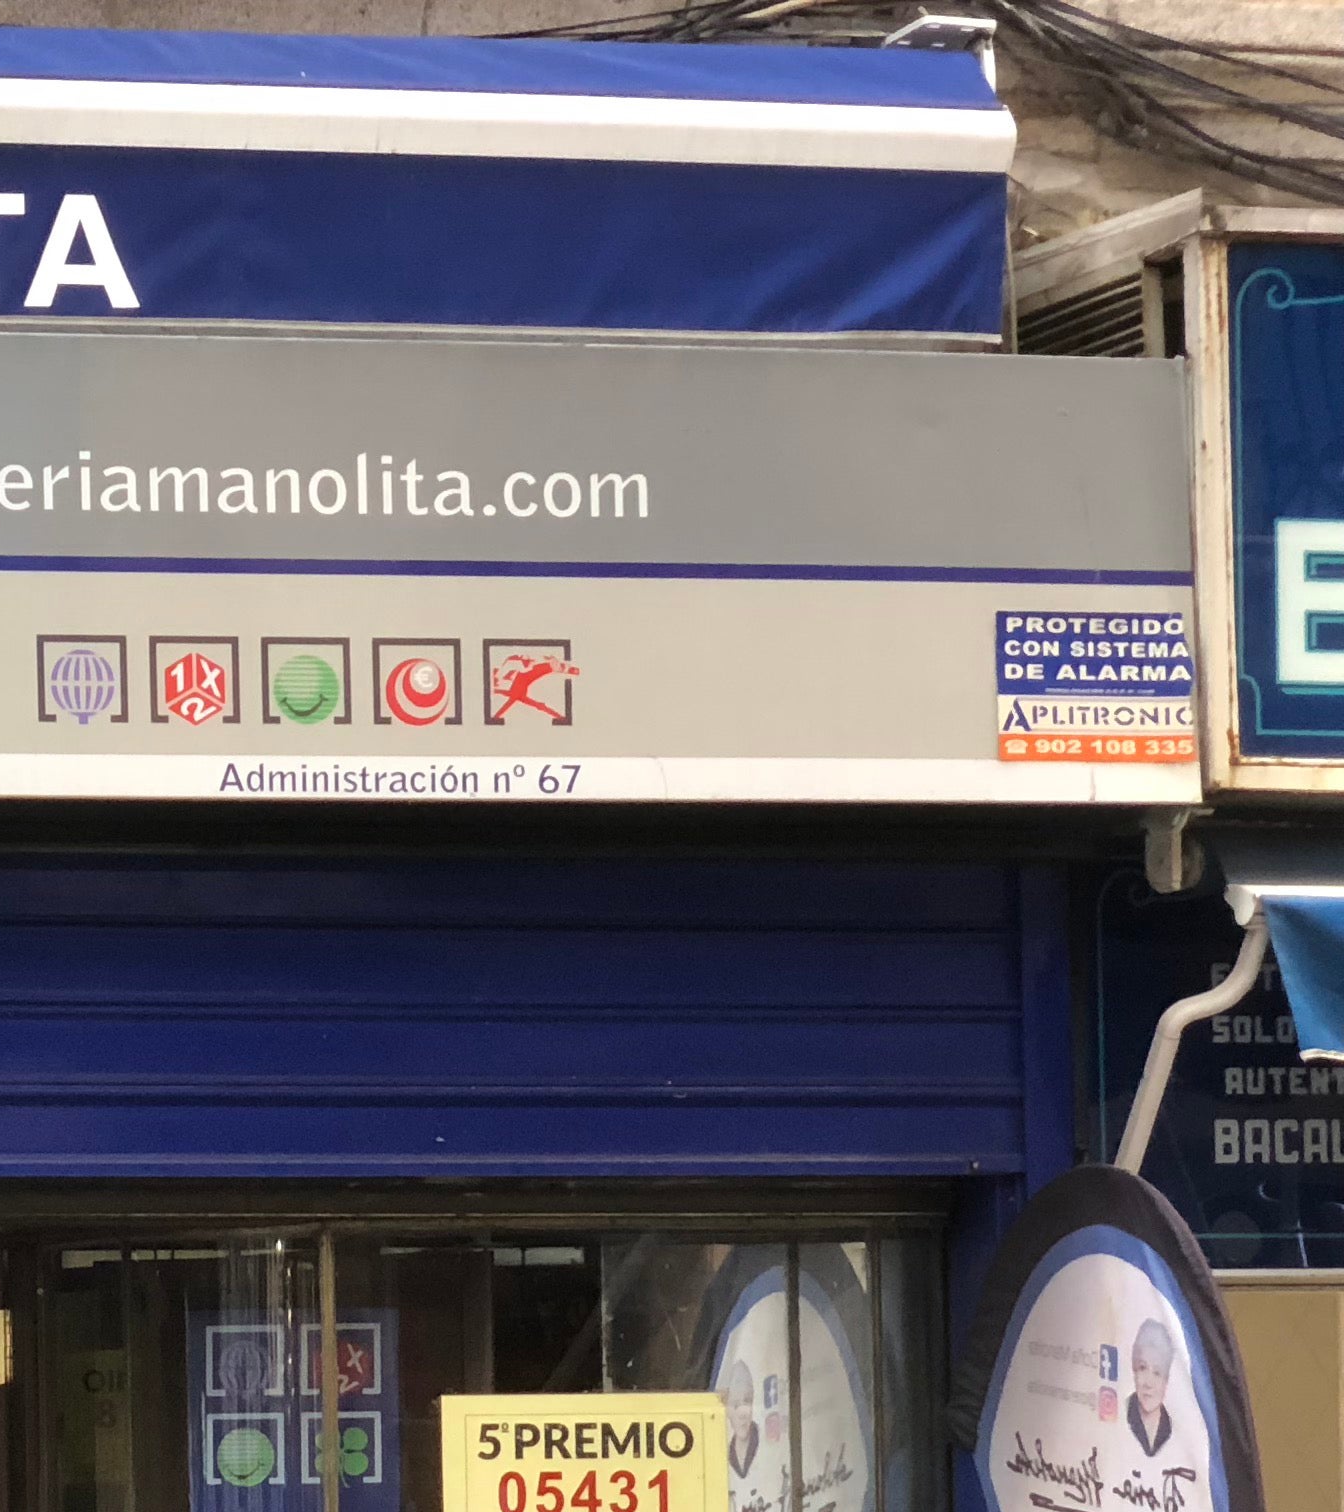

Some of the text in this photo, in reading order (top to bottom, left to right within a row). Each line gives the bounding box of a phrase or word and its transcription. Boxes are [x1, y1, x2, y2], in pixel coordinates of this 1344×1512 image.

[1005, 617, 1185, 635] PROTEGIDO
[1004, 640, 1190, 659] CON SISTEMA
[1004, 663, 1192, 682] DE ALARMA
[1002, 699, 1194, 732] APLITRONIC
[1034, 737, 1194, 755] 902 108 335
[219, 760, 479, 795] Administración
[536, 765, 581, 794] 67
[1213, 1015, 1296, 1044] SOLO
[514, 1421, 694, 1461] PREMIO
